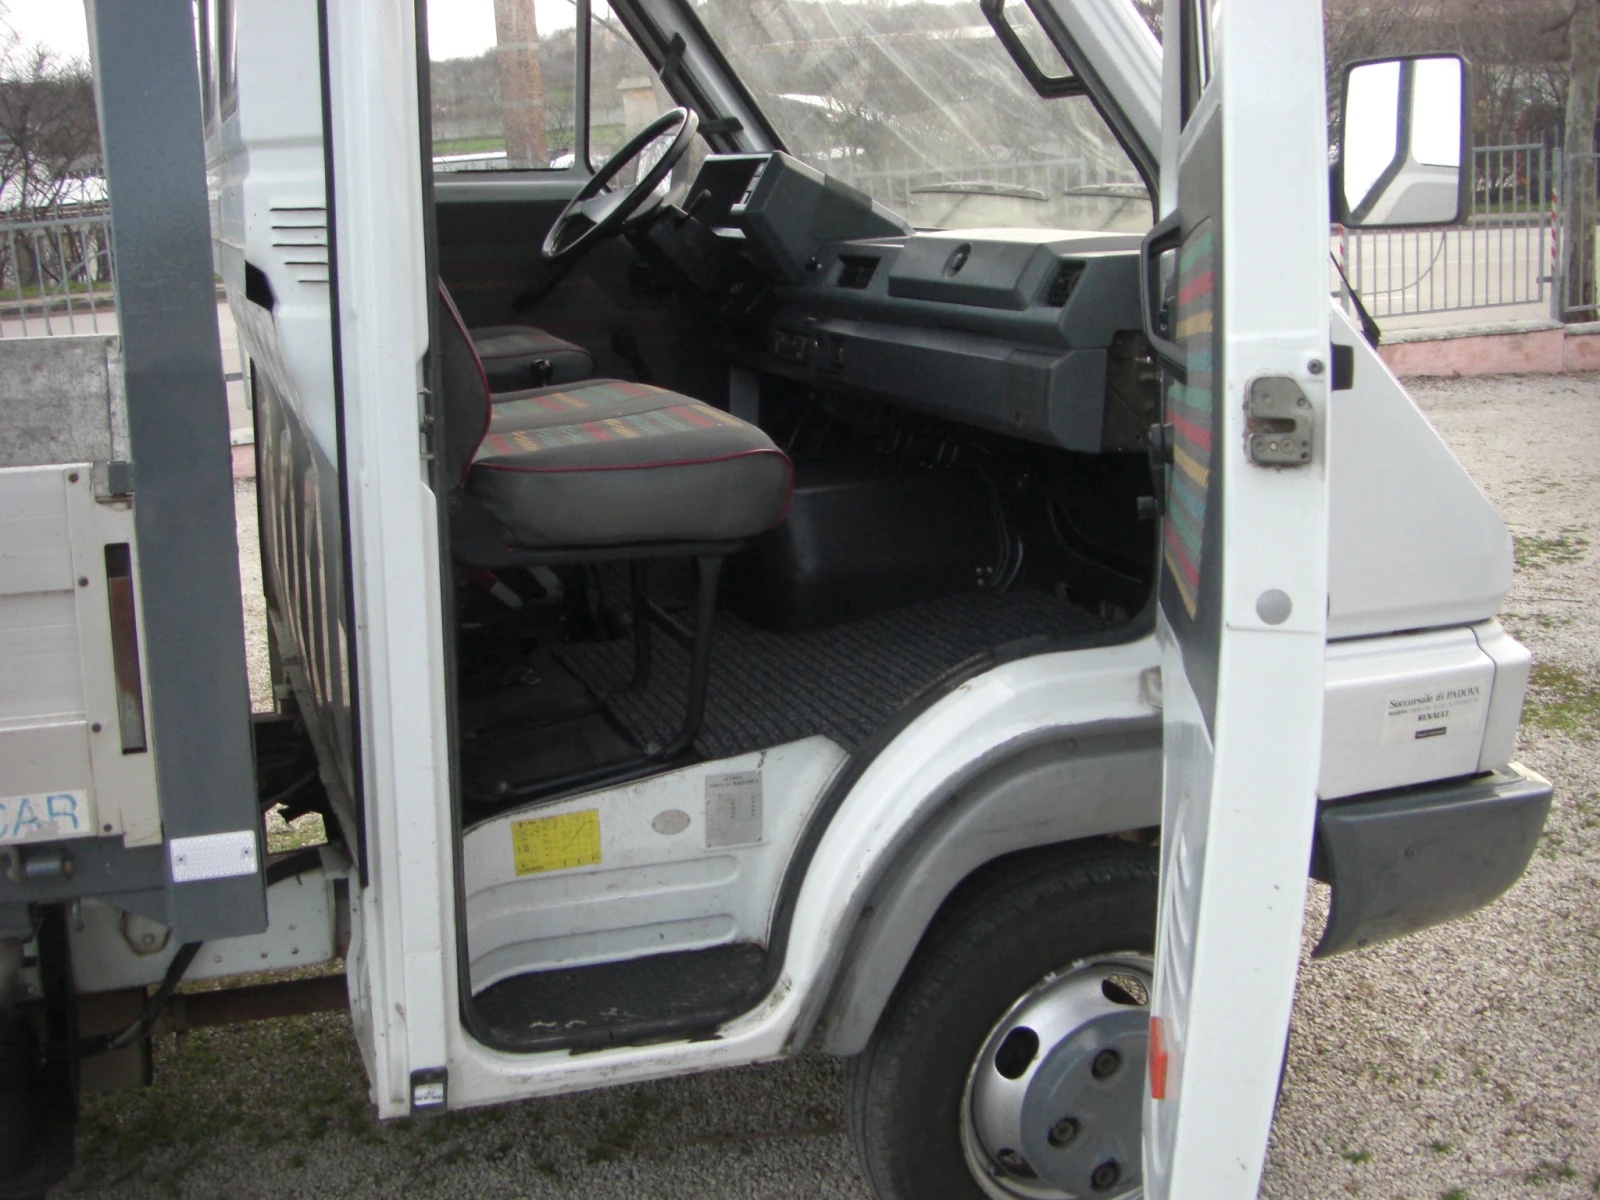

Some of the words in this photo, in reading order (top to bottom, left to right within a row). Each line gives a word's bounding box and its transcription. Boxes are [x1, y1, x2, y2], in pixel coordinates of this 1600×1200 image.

[1389, 694, 1433, 708] Succursale
[1435, 692, 1445, 701] di
[1446, 686, 1480, 699] PADOVA
[1418, 710, 1449, 721] RENAULT
